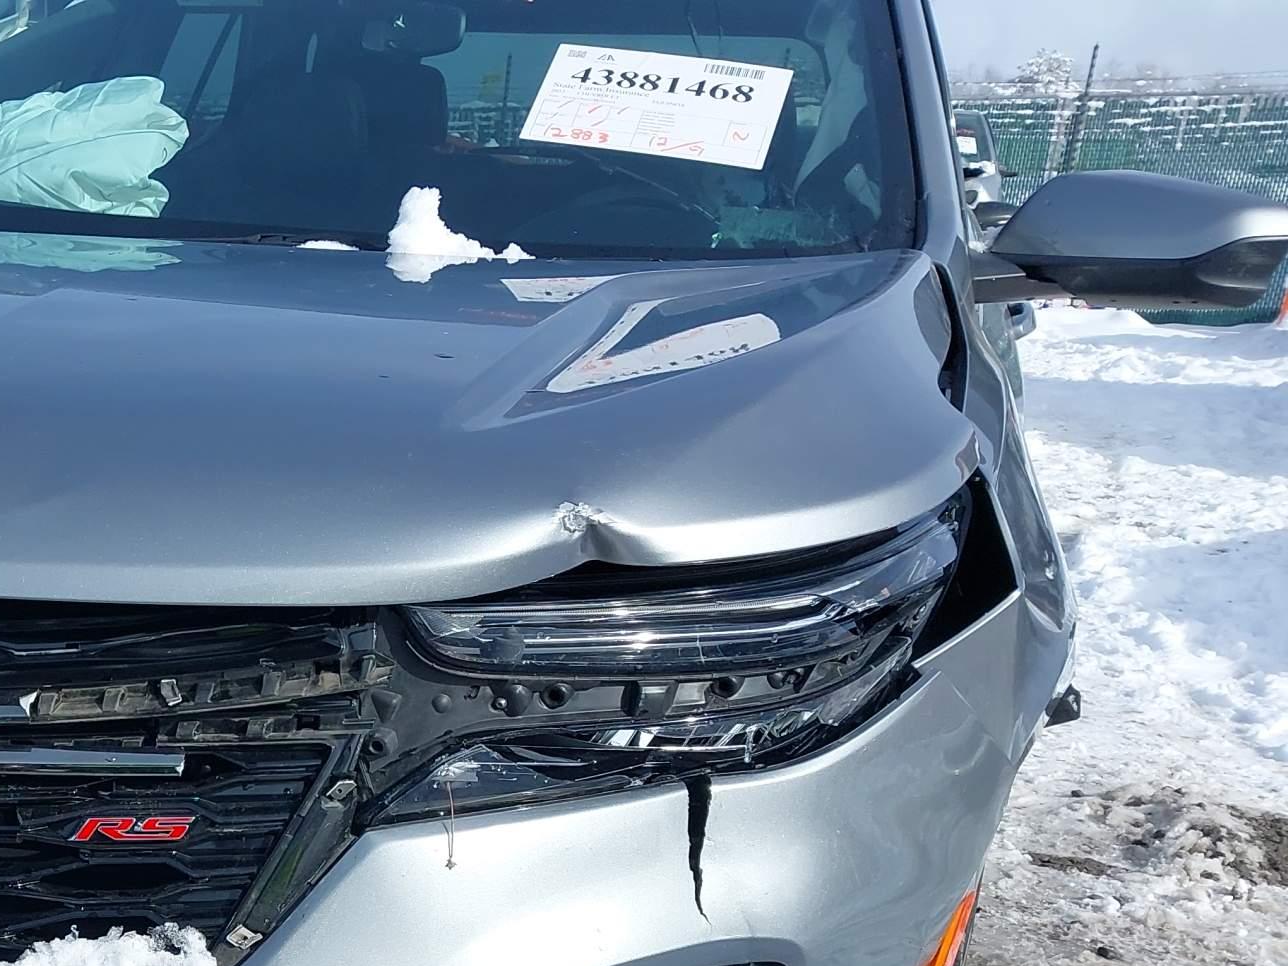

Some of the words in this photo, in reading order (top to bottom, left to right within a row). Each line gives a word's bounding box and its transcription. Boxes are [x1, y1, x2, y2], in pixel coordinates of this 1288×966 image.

[570, 66, 755, 103] 43881468
[578, 84, 603, 94] Farm
[605, 86, 650, 98] Insurance
[71, 816, 195, 841] RS
